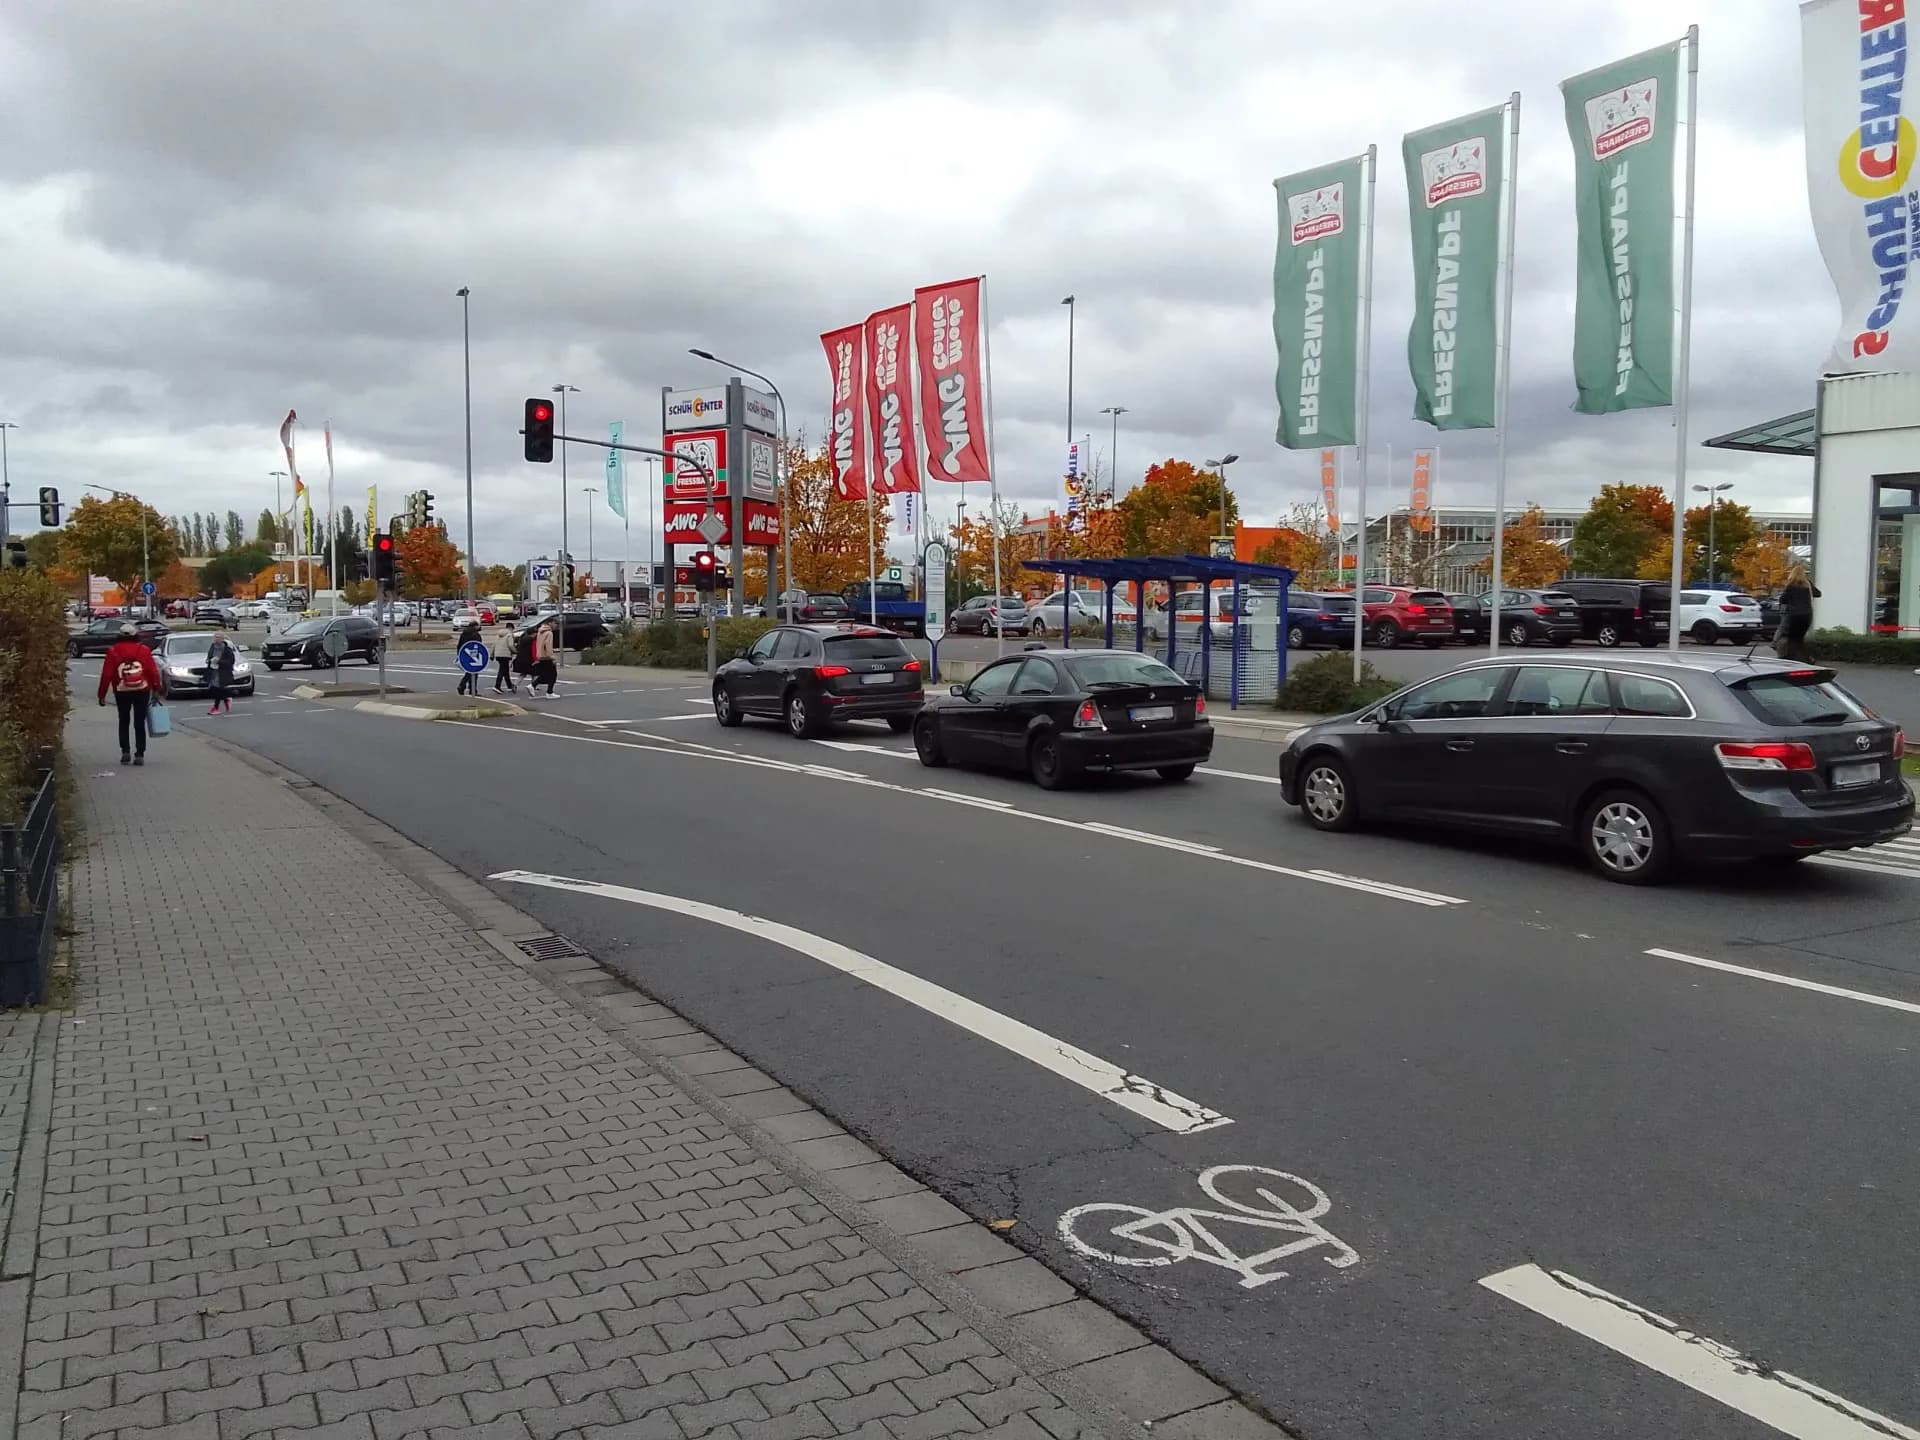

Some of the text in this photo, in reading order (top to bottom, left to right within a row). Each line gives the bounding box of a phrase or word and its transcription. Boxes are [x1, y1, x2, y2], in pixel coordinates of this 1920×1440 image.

[668, 400, 723, 416] SCHUH CENTER
[665, 513, 698, 533] AWG
[891, 569, 900, 579] D
